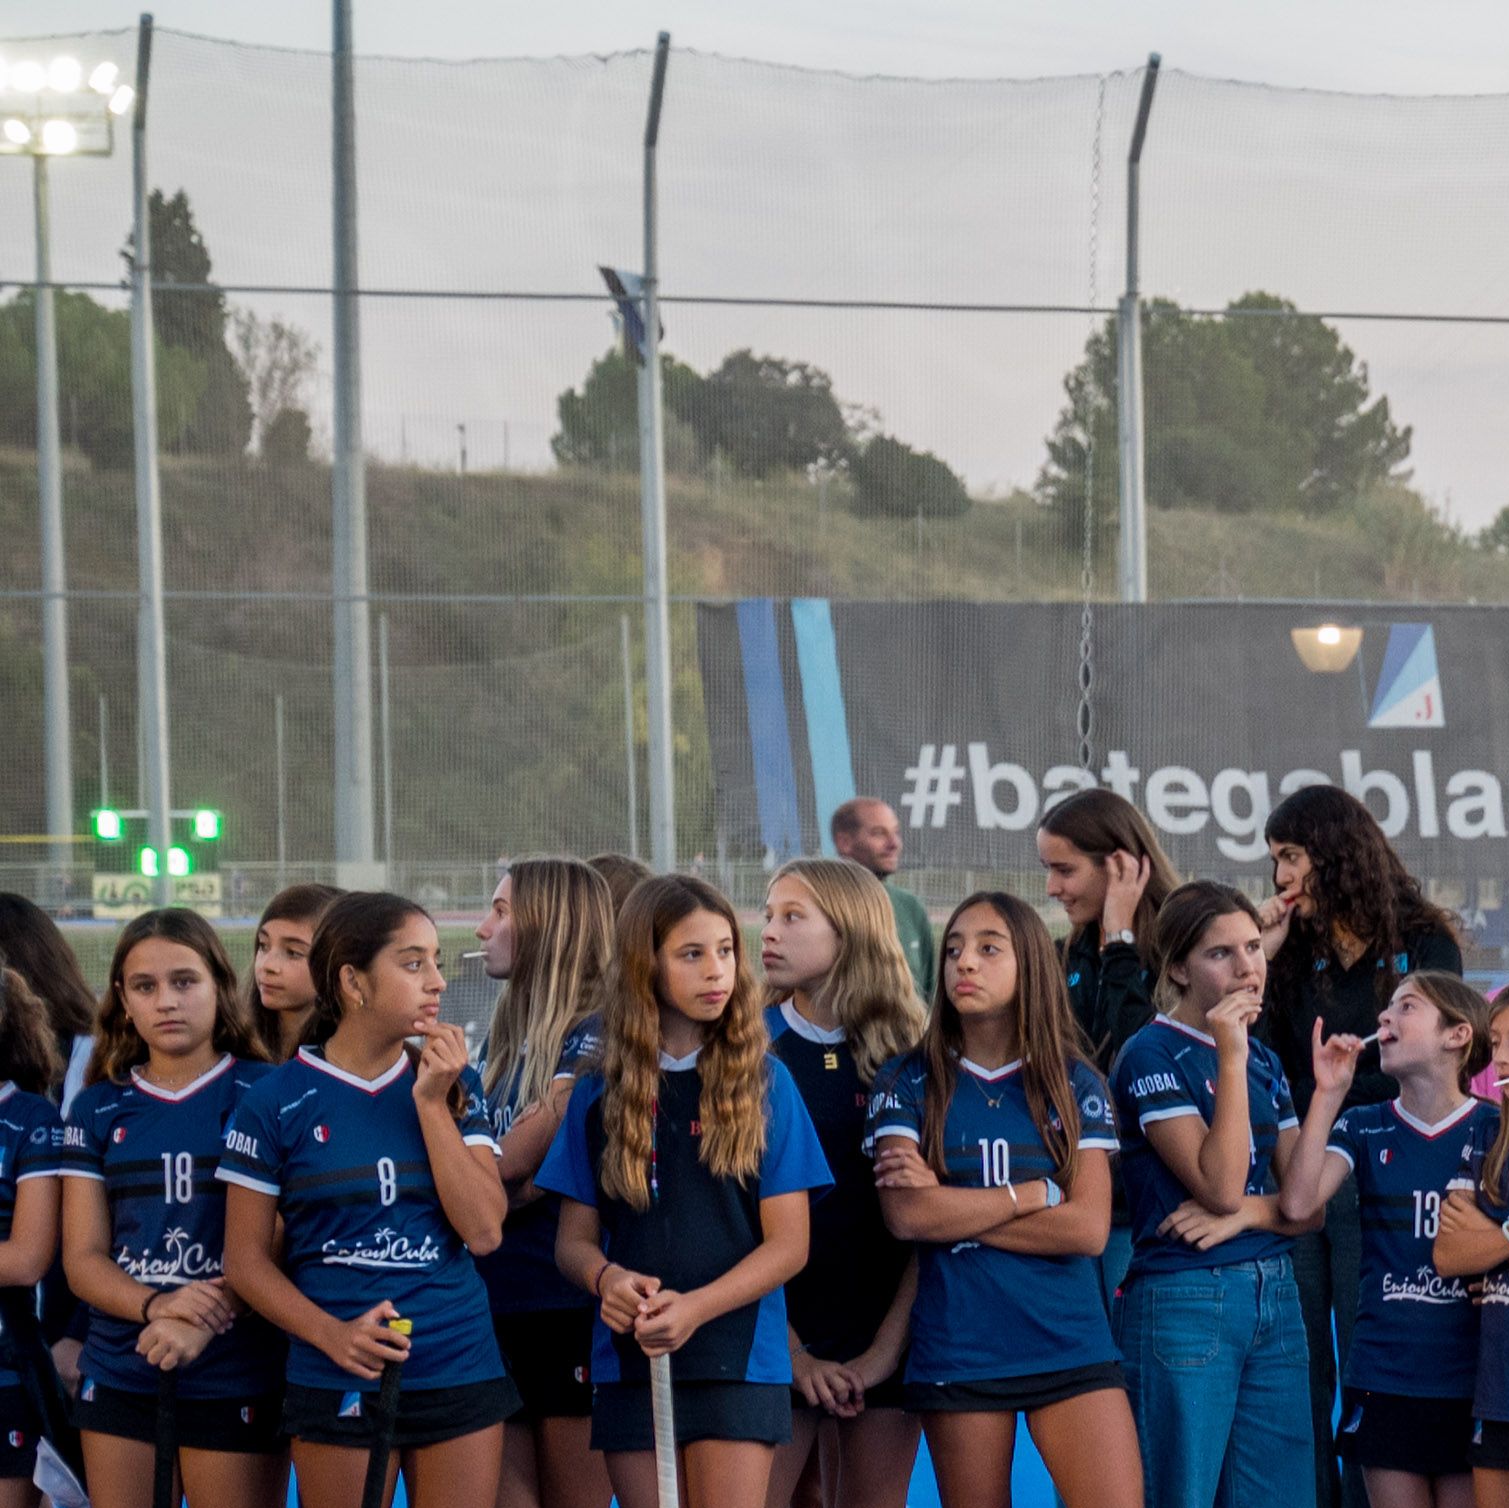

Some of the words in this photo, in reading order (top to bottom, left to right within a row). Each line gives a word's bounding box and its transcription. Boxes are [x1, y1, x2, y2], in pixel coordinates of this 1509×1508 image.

[161, 1152, 193, 1204] 18
[377, 1156, 397, 1206] 8
[978, 1138, 1010, 1187] 10
[1412, 1190, 1440, 1239] 13
[182, 1243, 225, 1275] Cu
[391, 1236, 440, 1262] Cuba
[1382, 1272, 1428, 1295] Enjoy
[1428, 1274, 1468, 1298] Cuba
